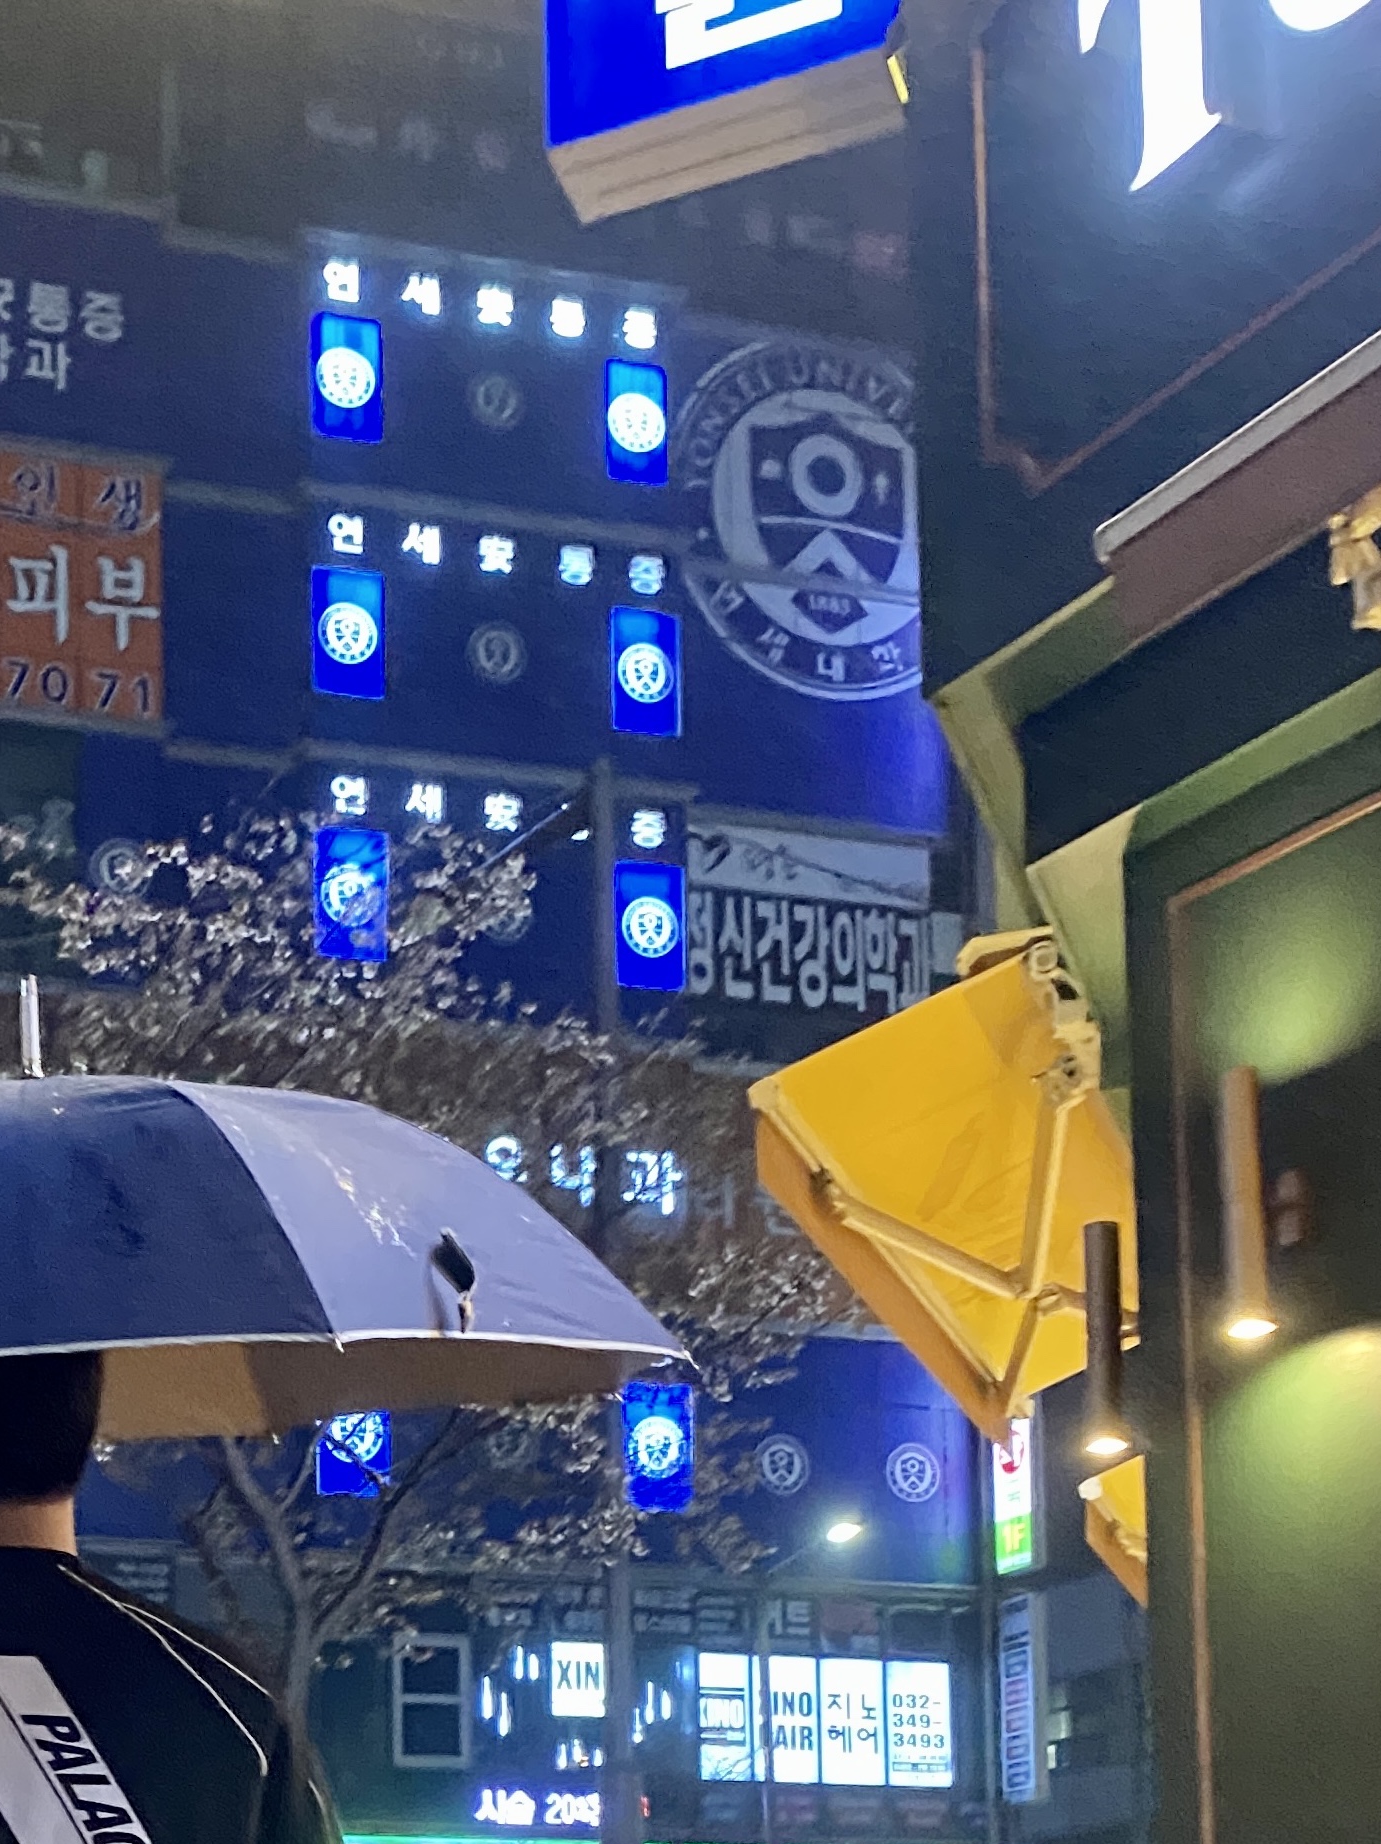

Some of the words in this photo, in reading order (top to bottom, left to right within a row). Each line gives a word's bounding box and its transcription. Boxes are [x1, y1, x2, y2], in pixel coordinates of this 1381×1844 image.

[556, 1659, 602, 1691] XIN
[892, 1693, 942, 1710] 032-
[892, 1712, 943, 1729] 349-
[827, 1724, 879, 1755] 헤어
[893, 1732, 946, 1750] 3493
